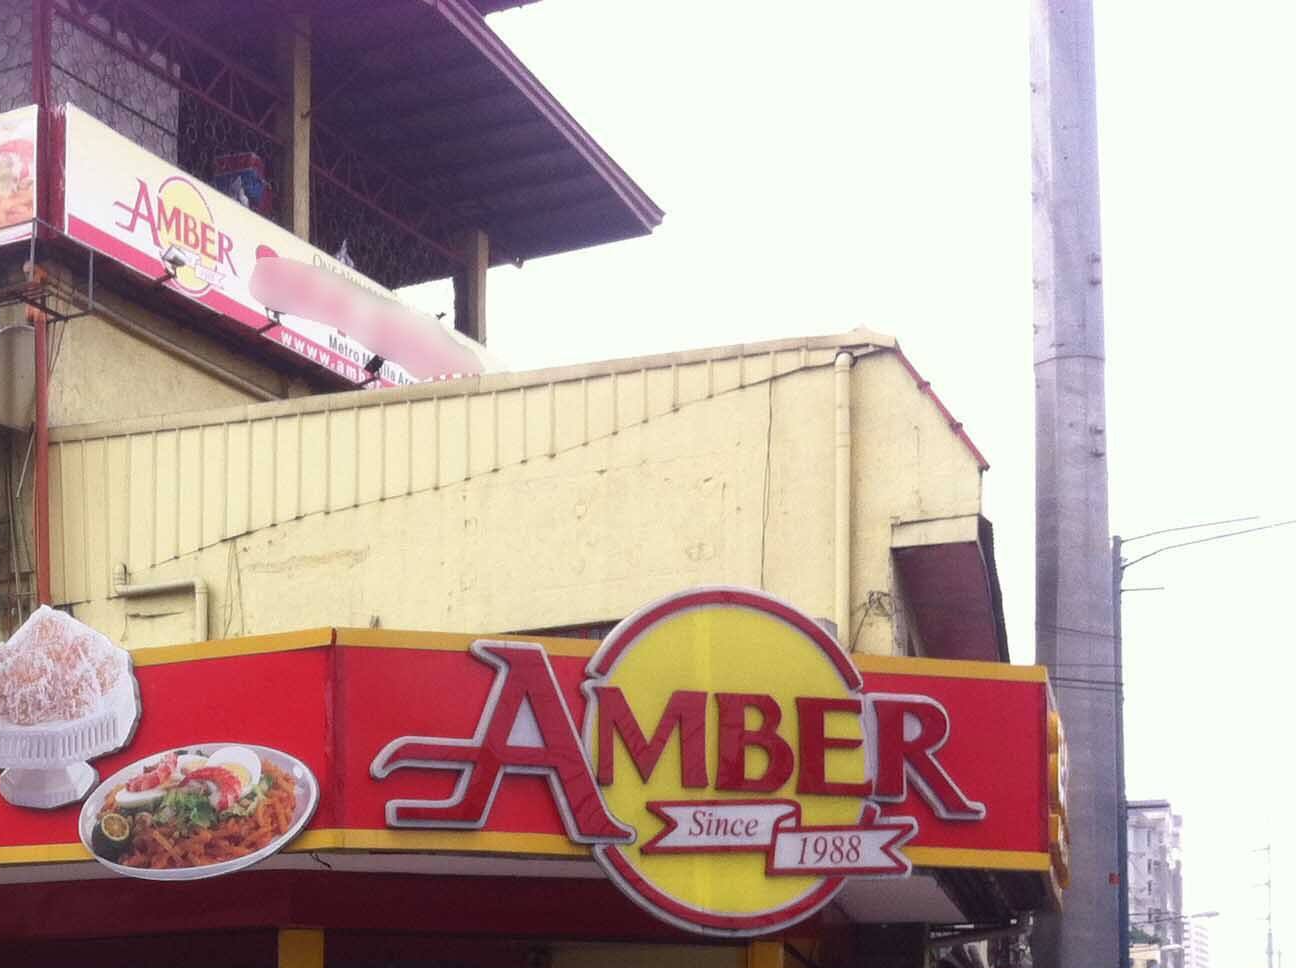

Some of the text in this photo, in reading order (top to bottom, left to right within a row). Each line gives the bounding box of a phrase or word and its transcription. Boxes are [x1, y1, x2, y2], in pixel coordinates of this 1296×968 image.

[113, 177, 240, 278] AMBER
[328, 333, 360, 362] Metro
[370, 639, 986, 846] AMBER
[688, 810, 760, 837] Since
[798, 835, 862, 865] 1988
